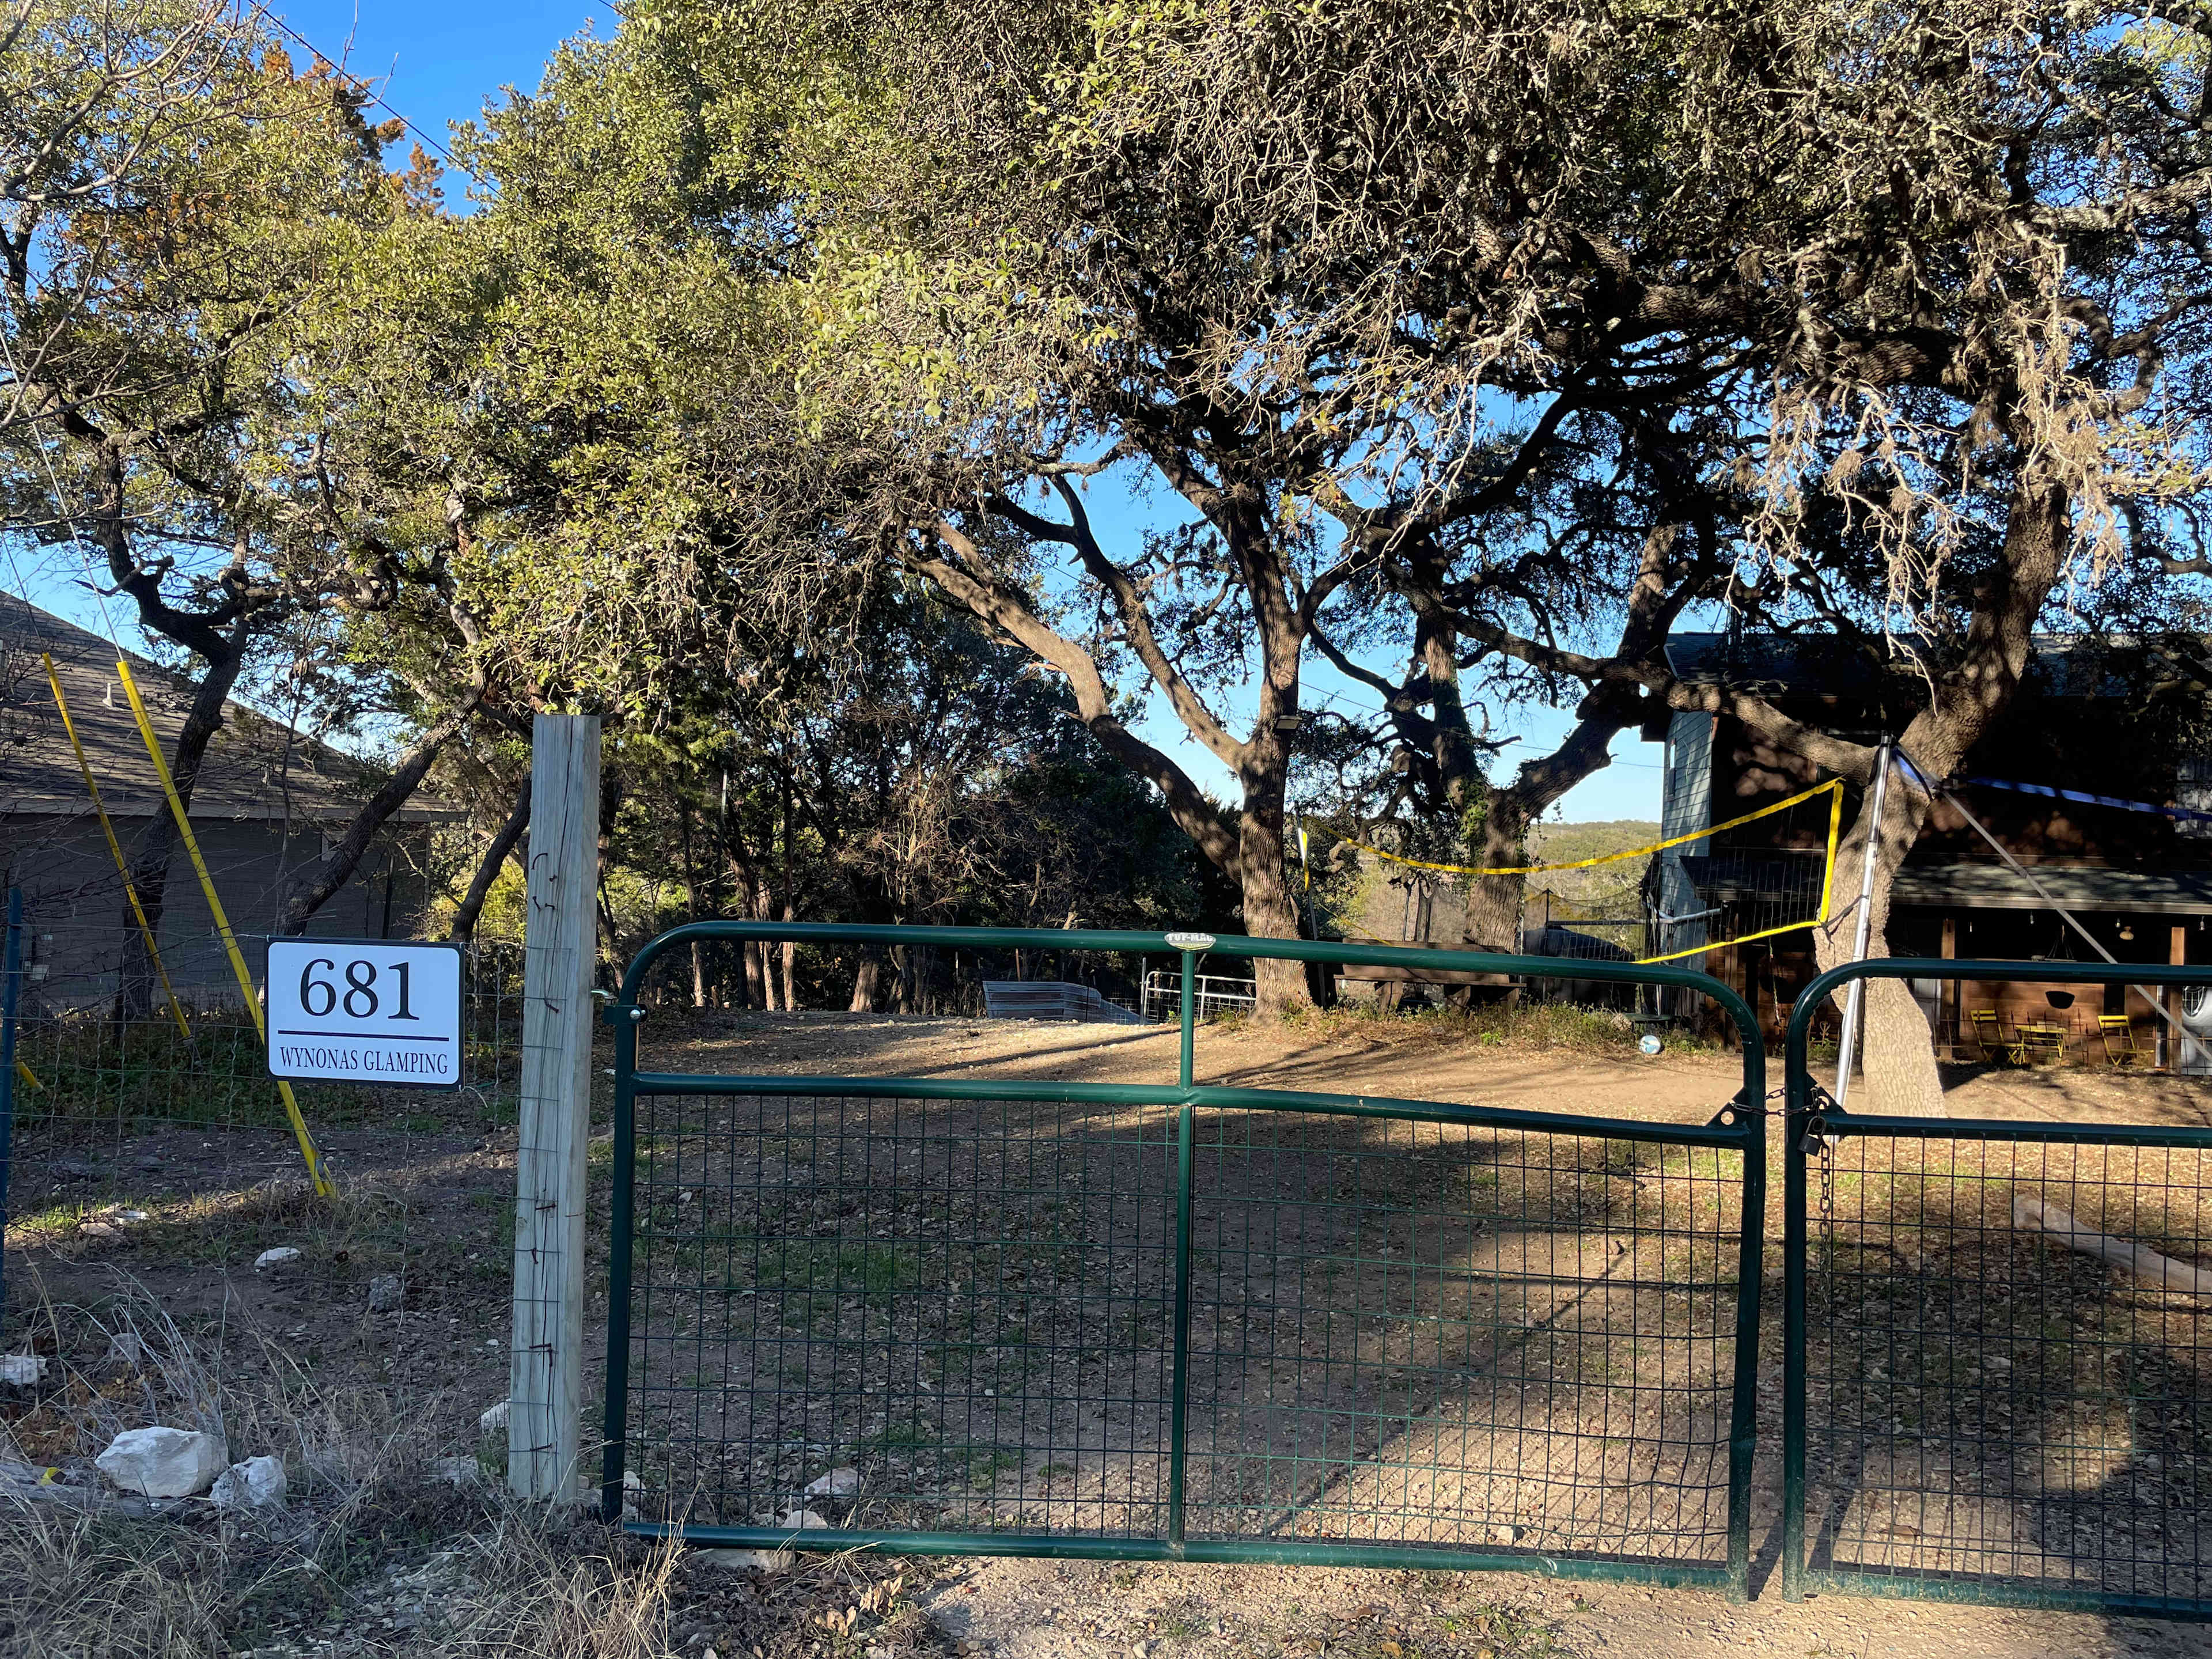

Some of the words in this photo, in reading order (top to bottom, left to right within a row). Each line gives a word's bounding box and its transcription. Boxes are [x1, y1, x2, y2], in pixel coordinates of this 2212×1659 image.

[300, 959, 419, 1020] 681
[280, 1047, 358, 1070] WYNONAS
[364, 1050, 448, 1074] GLAMPING
